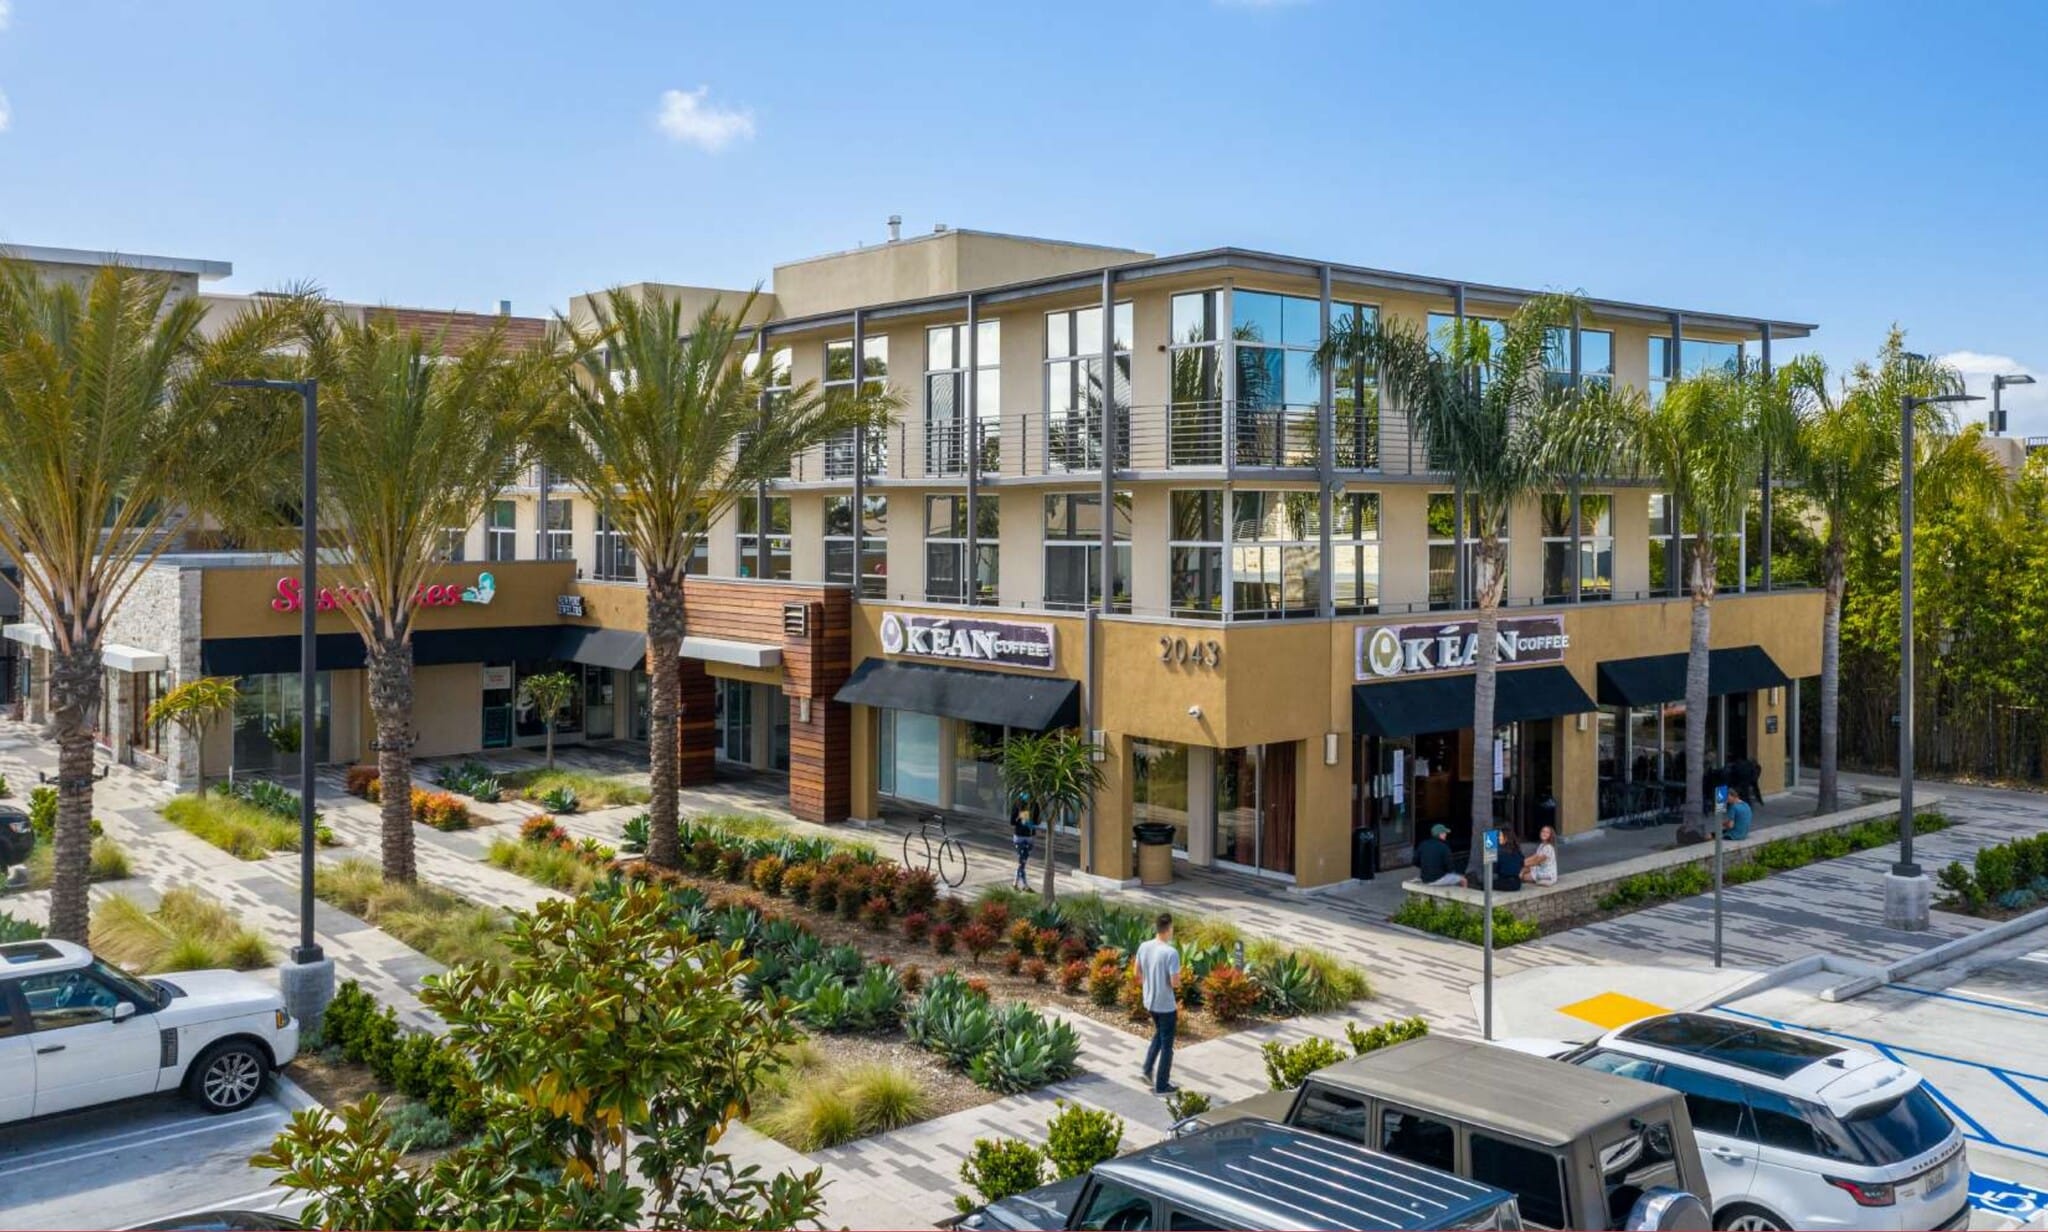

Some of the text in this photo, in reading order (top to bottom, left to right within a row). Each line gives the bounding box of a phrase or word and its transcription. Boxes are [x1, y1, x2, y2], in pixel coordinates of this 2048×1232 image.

[993, 639, 1050, 657] COFFEE
[1159, 635, 1221, 668] 2043
[1517, 634, 1570, 651] COFFEE
